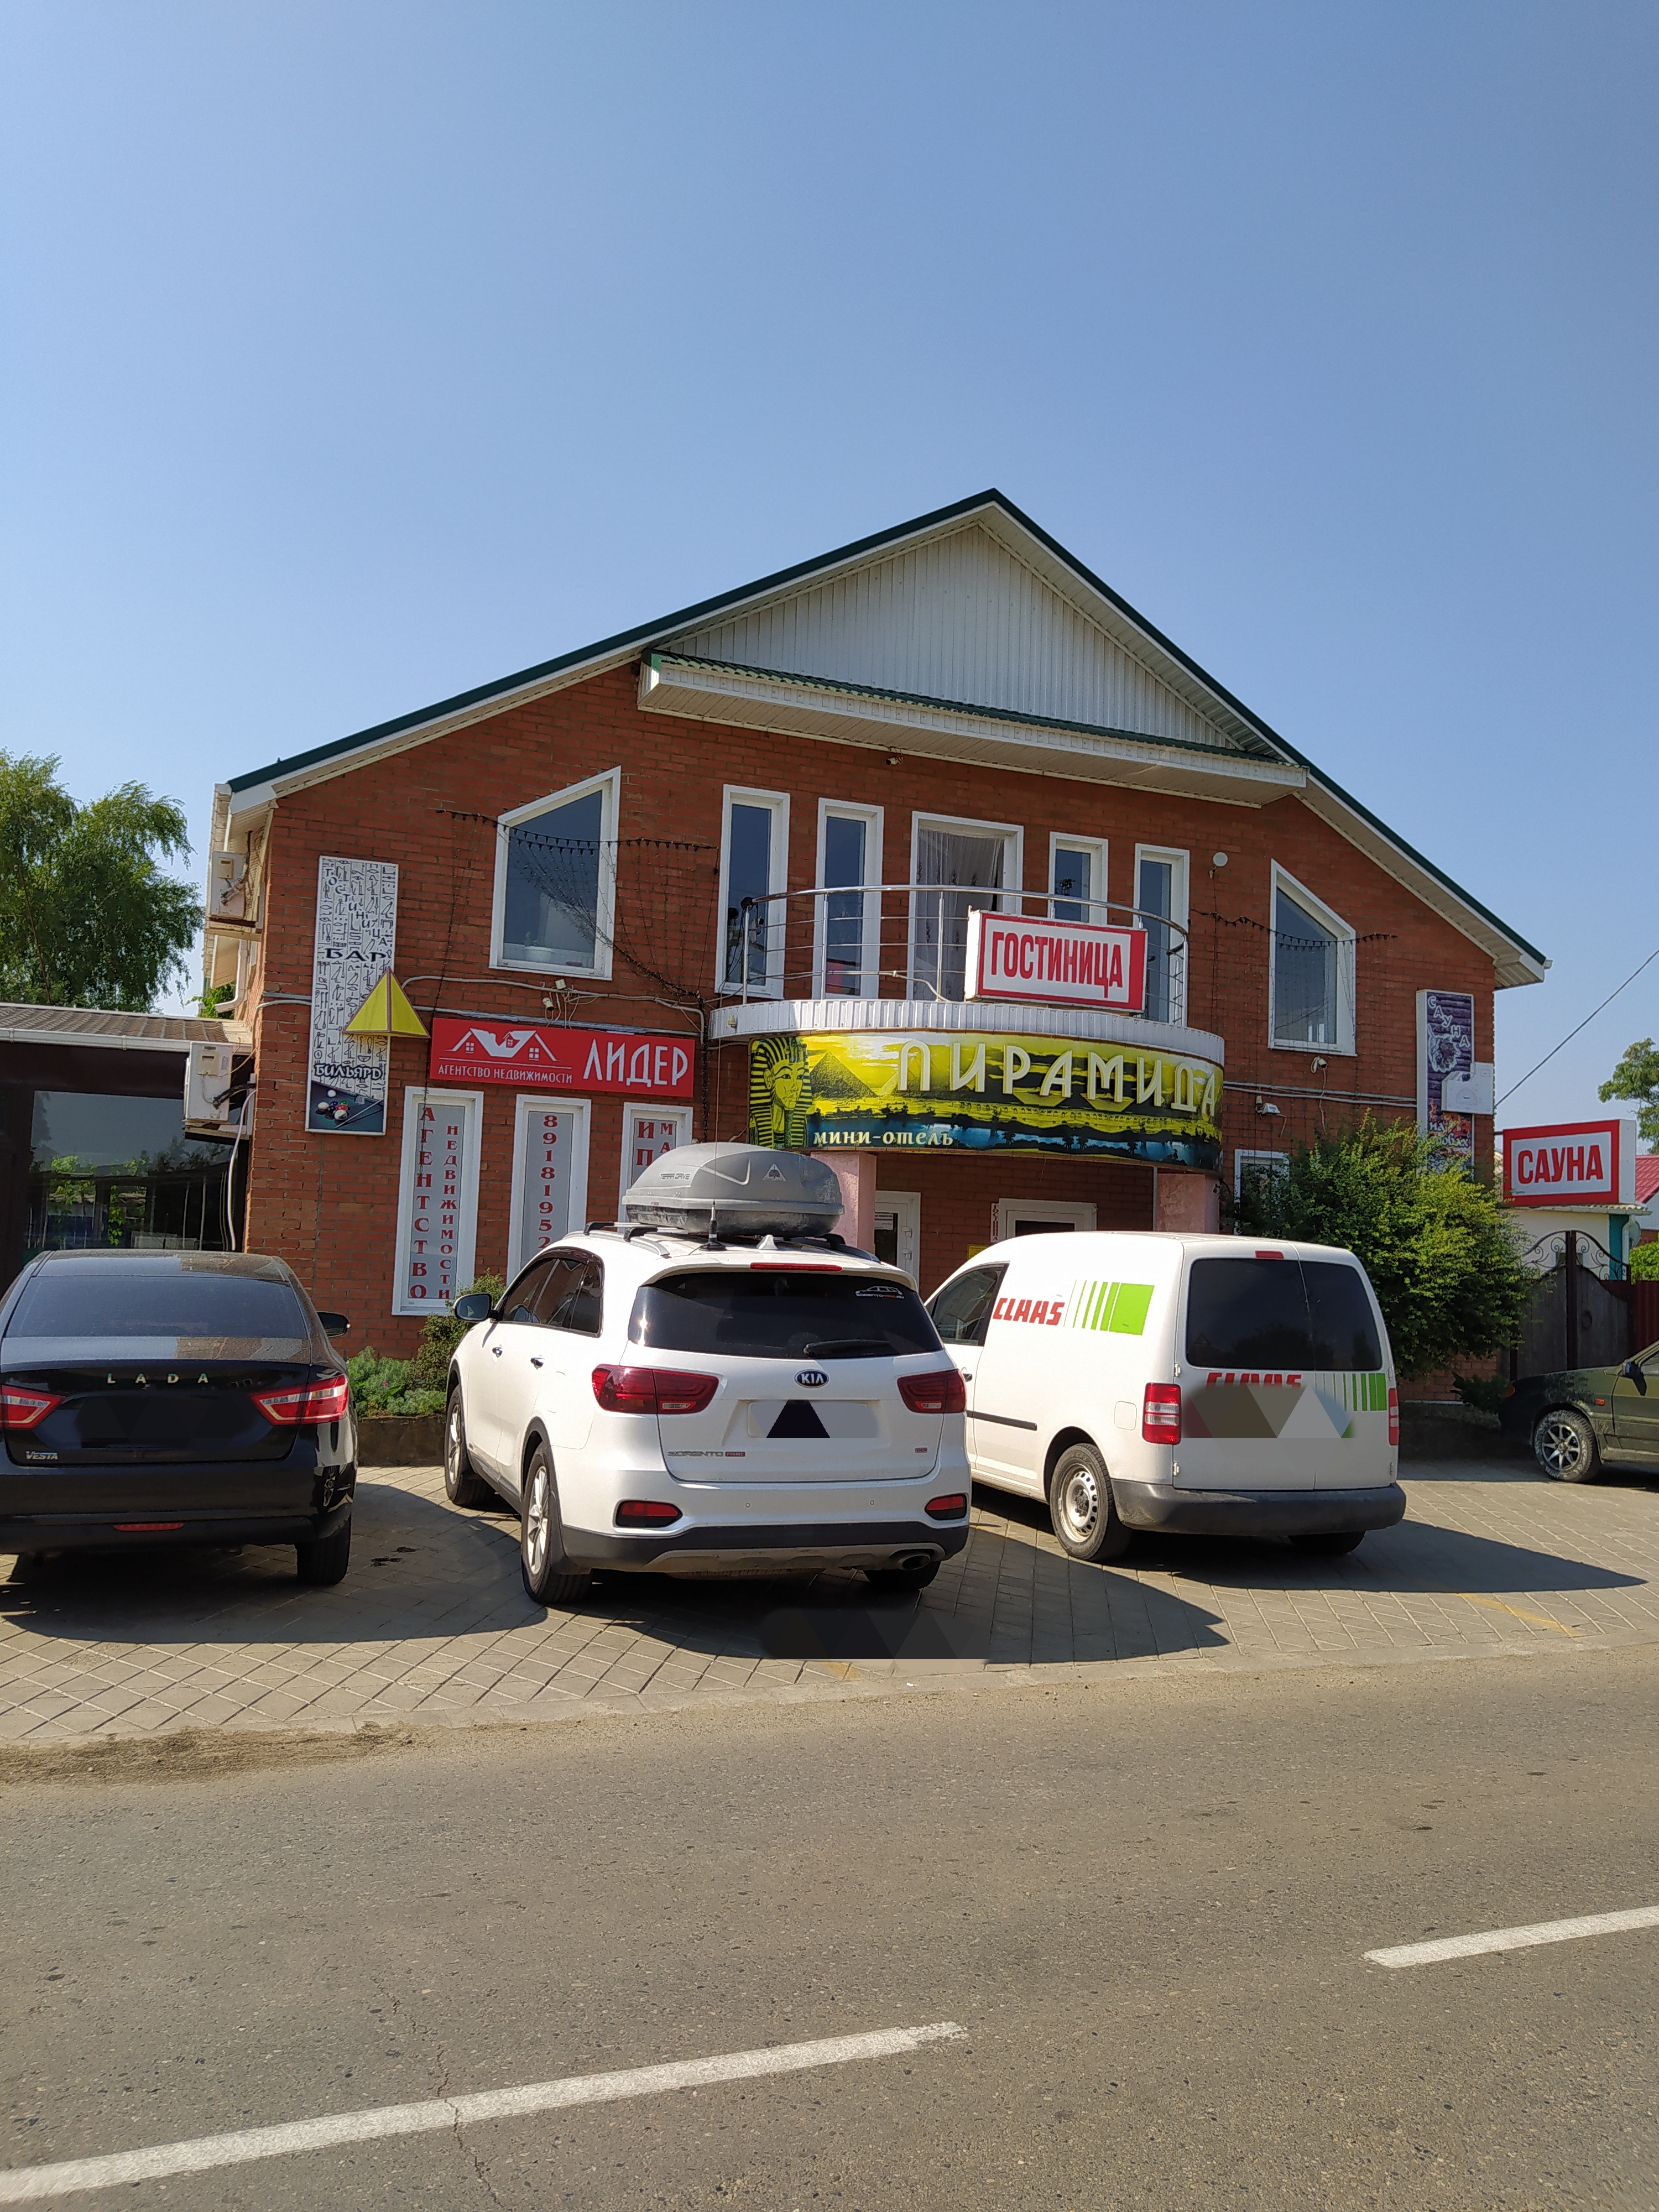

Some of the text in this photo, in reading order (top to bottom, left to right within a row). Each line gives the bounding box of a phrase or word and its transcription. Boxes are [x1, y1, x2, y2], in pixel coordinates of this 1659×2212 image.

[324, 948, 387, 962] БАР
[991, 931, 1123, 998] ГОСТИНИЦА
[1428, 996, 1470, 1048] САУНА
[438, 1064, 572, 1084] АГЕНТСТВО НЕДВИЖИМОСТИ
[583, 1038, 688, 1088] ЛИДЕР
[898, 1040, 1215, 1118] ПИРАМИДА
[635, 1121, 656, 1166] ИП
[813, 1131, 954, 1146] мини-отель
[538, 1114, 558, 1249] 89181952
[1517, 1144, 1604, 1185] САУНА
[410, 1107, 436, 1299] АГЕНТСТВО
[439, 1125, 458, 1300] НЕДВИЖИМОСТИ
[992, 1297, 1066, 1326] CLAAS
[107, 1373, 209, 1384] LADA
[800, 1373, 825, 1384] KIA
[25, 1451, 59, 1460] VESTA
